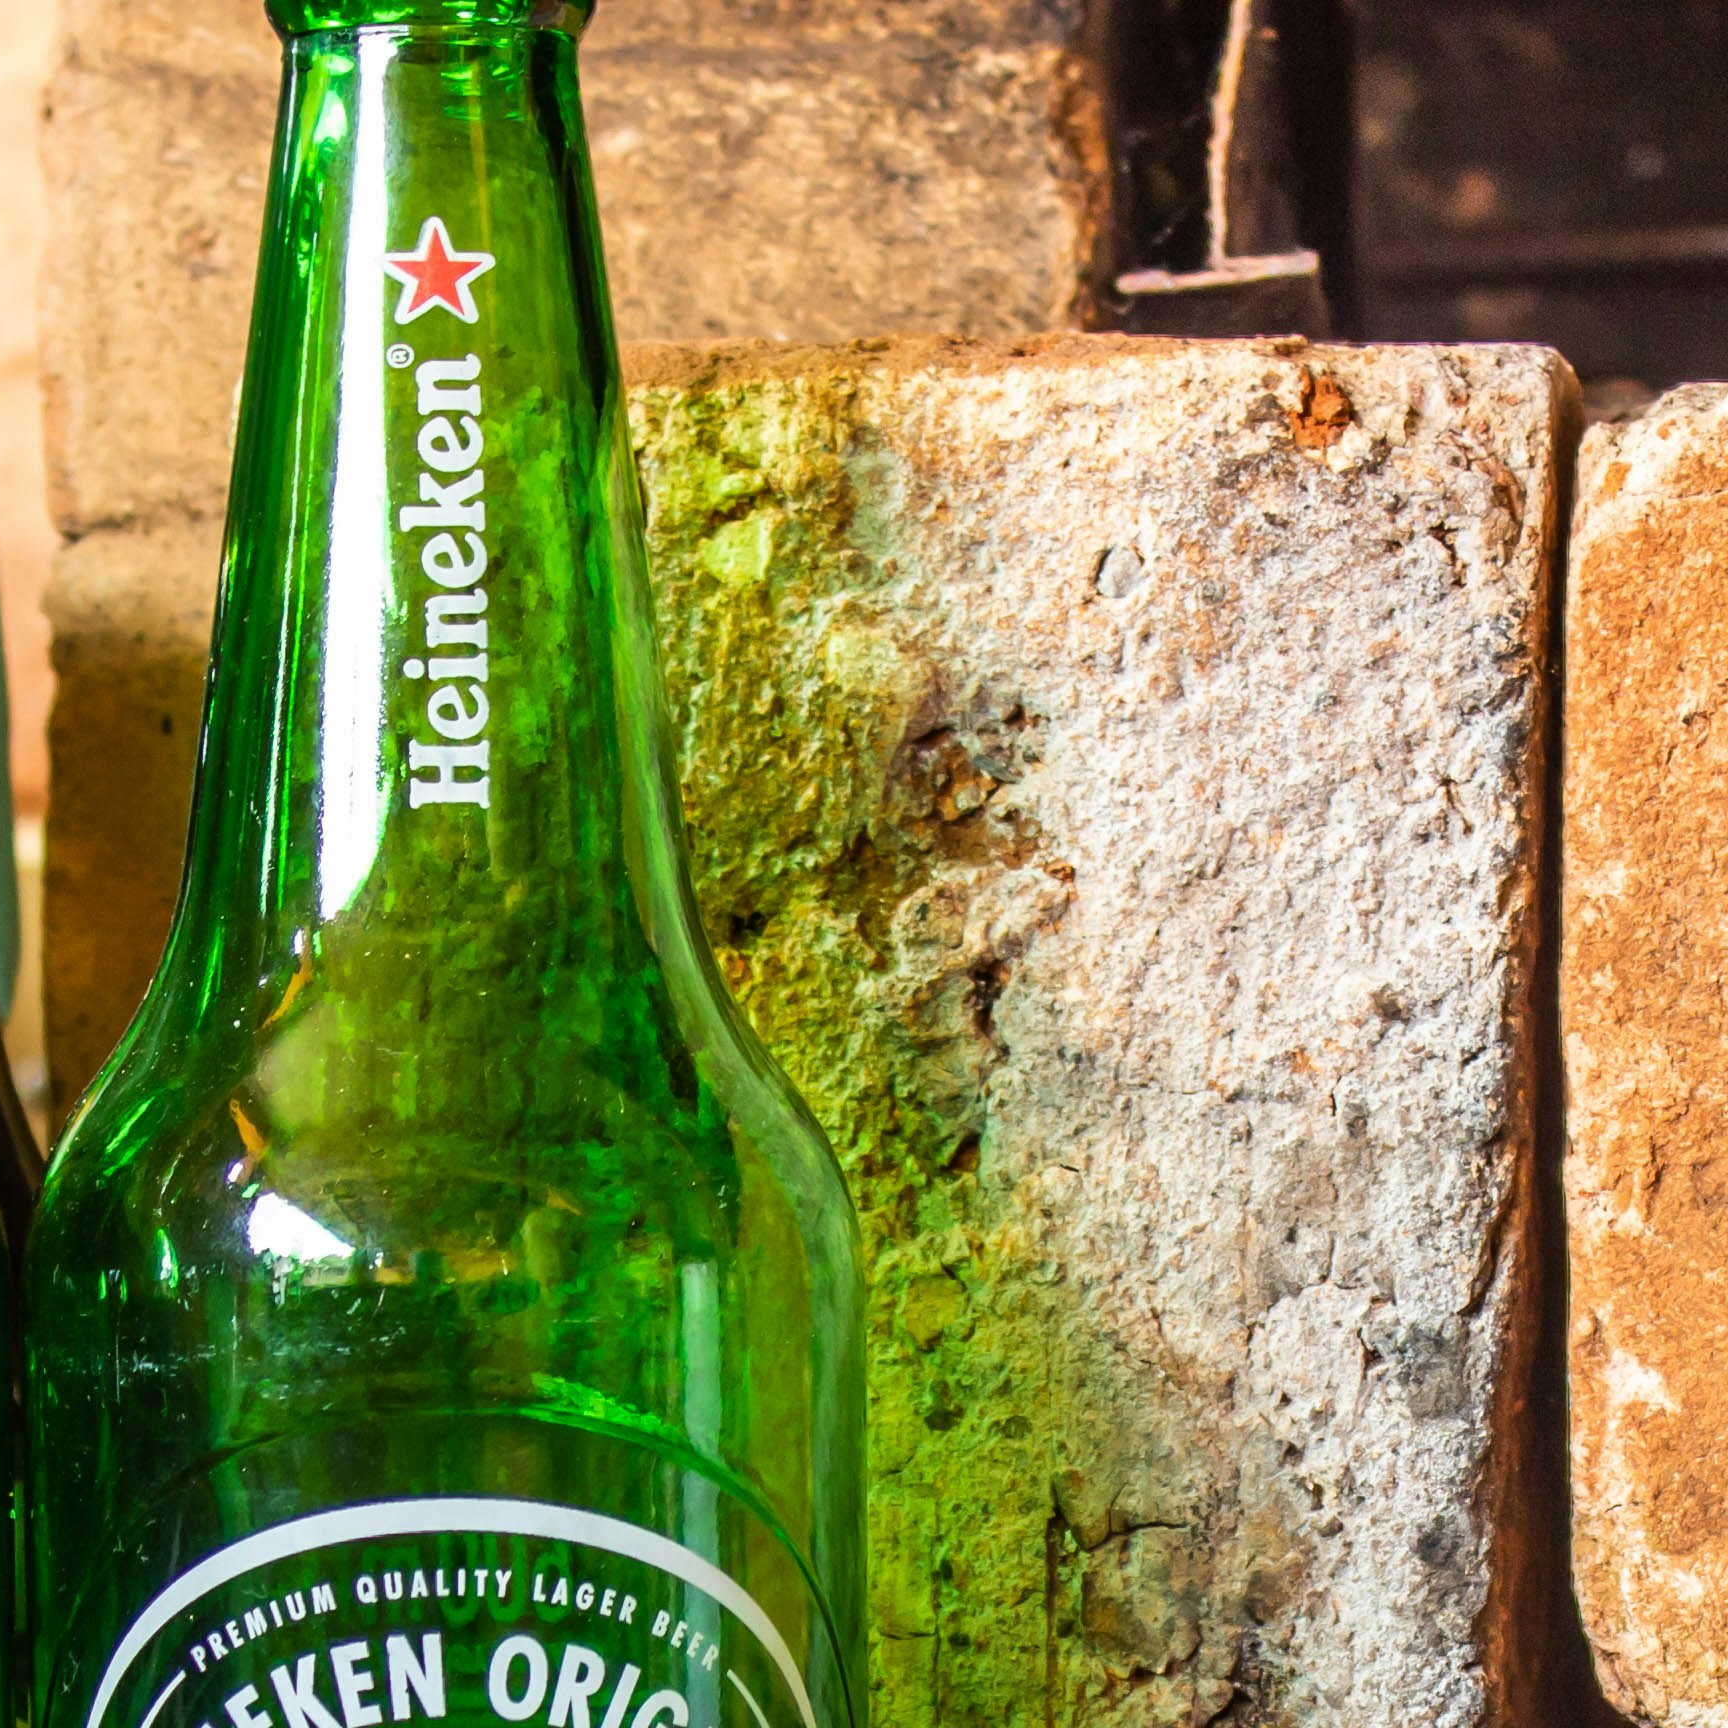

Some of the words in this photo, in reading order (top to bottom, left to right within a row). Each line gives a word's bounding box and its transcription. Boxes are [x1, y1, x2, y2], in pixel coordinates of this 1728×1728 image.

[399, 353, 490, 810] Heineken
[190, 1584, 336, 1671] PREMIUM
[357, 1569, 512, 1603] QUALITY
[533, 1574, 636, 1624] LAGER
[652, 1610, 719, 1669] BEER
